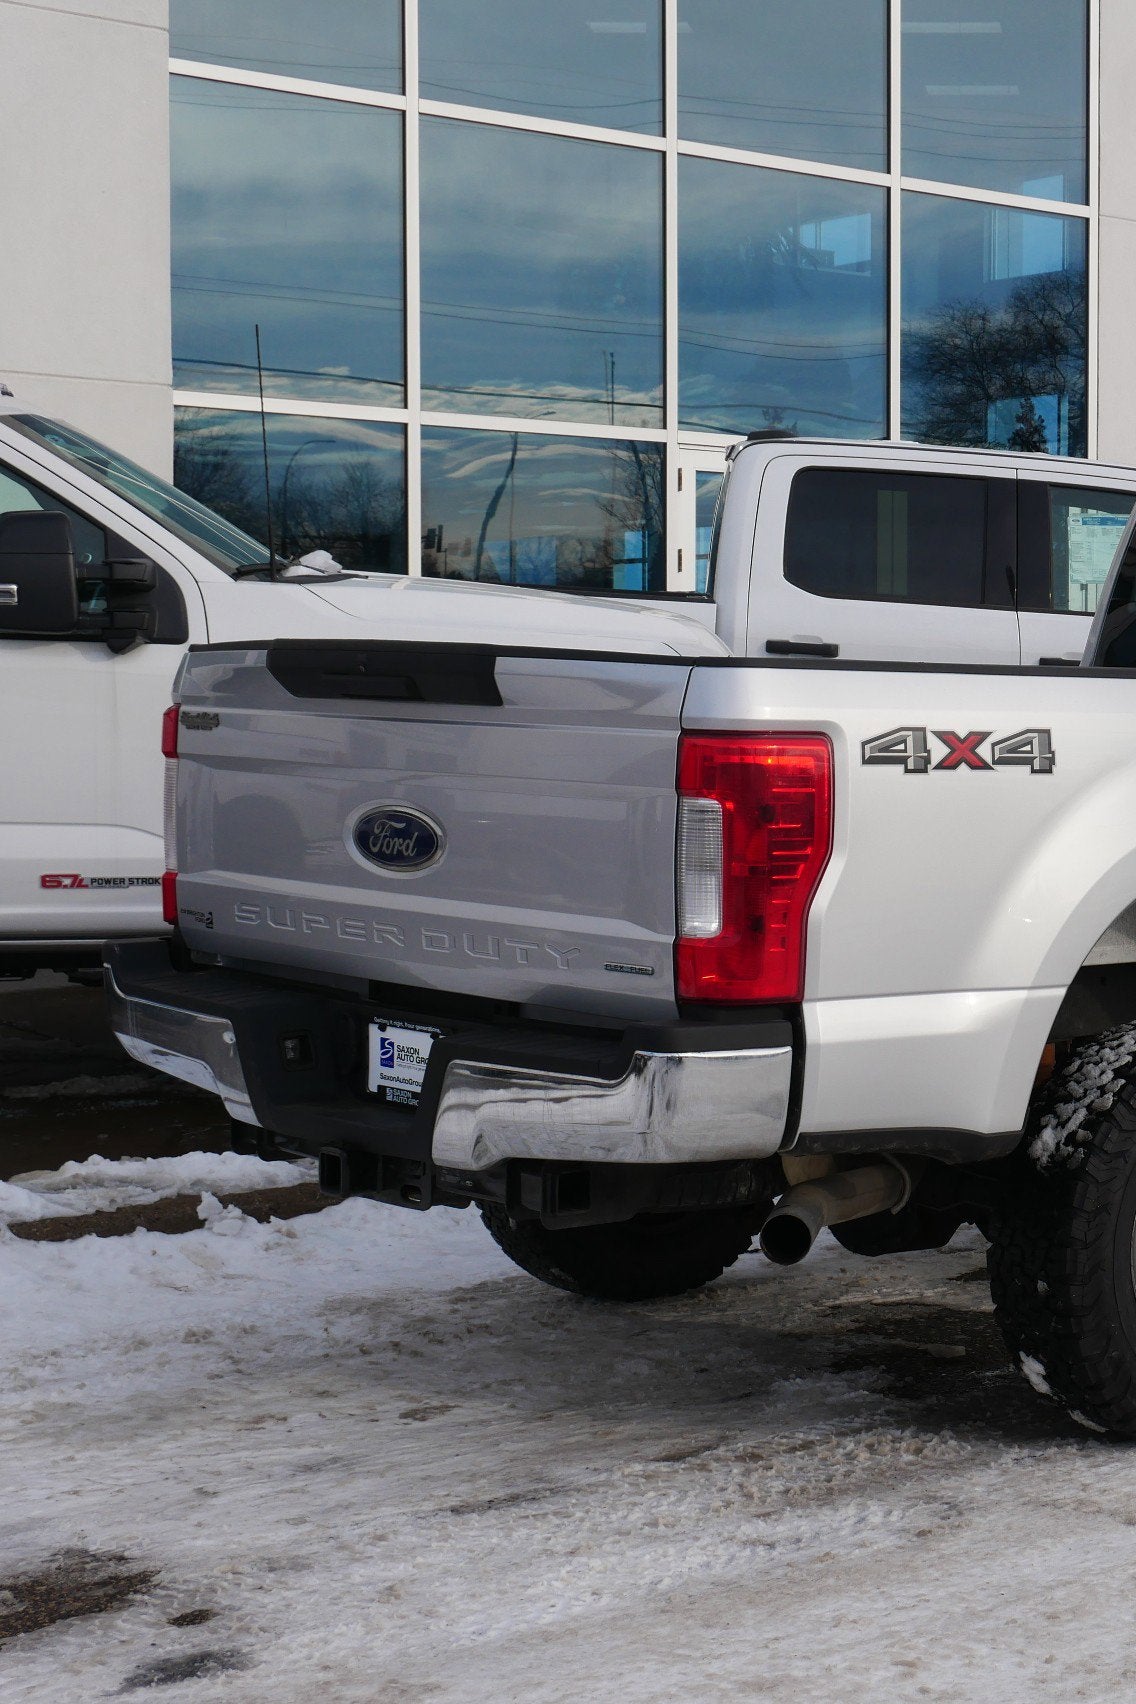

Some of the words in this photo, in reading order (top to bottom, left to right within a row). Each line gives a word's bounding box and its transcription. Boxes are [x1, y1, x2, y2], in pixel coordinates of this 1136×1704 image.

[861, 726, 1056, 774] 4X4
[369, 819, 417, 857] Ford
[41, 873, 89, 889] 6.7L
[90, 877, 126, 886] POWER
[233, 901, 406, 948] SUPER
[421, 927, 582, 970] DUTY
[396, 1045, 419, 1055] SAXON
[396, 1053, 414, 1062] AUTO
[392, 1095, 408, 1104] AUTO
